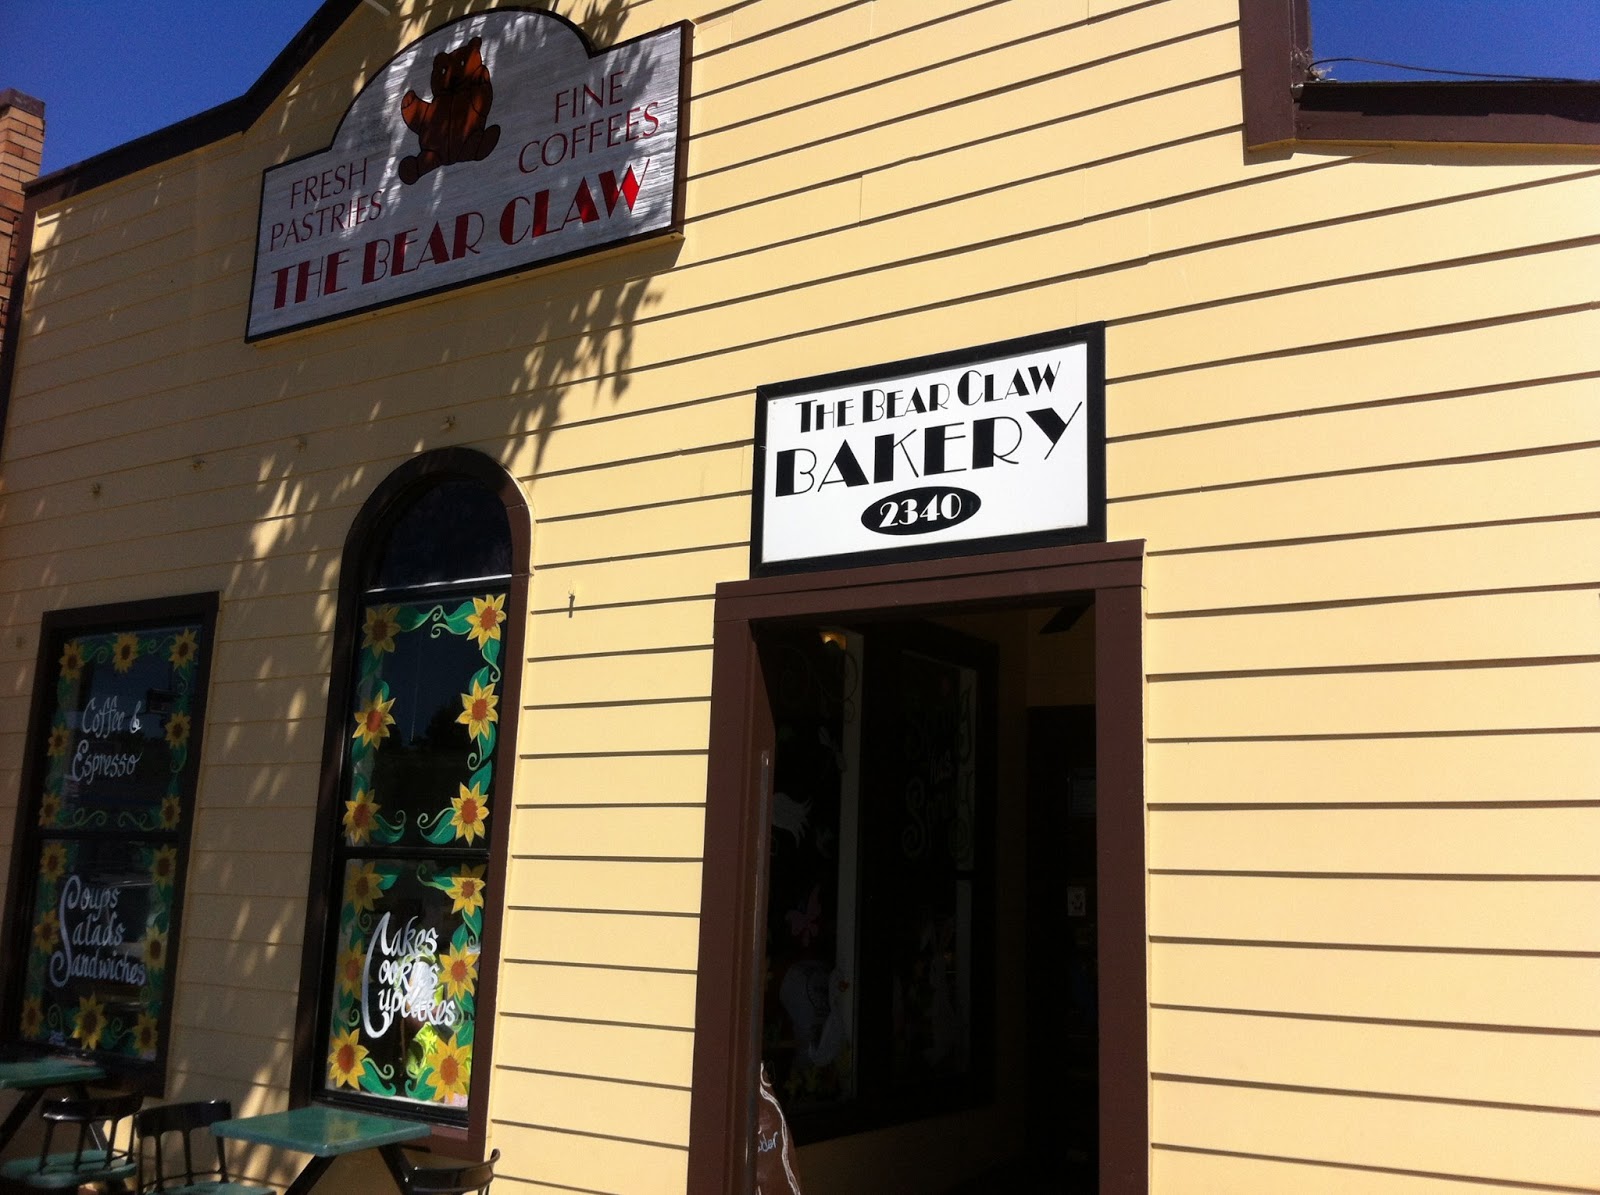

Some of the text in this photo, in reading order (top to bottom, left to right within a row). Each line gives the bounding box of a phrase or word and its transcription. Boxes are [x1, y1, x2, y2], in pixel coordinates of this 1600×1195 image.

[554, 70, 625, 124] FINE
[518, 101, 660, 174] COFFEES
[290, 157, 368, 209] FRESH
[270, 190, 383, 252] PASTRIES
[271, 158, 651, 310] THE BEAR CLAW
[795, 360, 1062, 434] THE BEAR CLAW
[775, 401, 1083, 498] BAKERY
[879, 492, 963, 529] 2340
[82, 695, 126, 739] Coffee
[72, 739, 144, 785] Espresso
